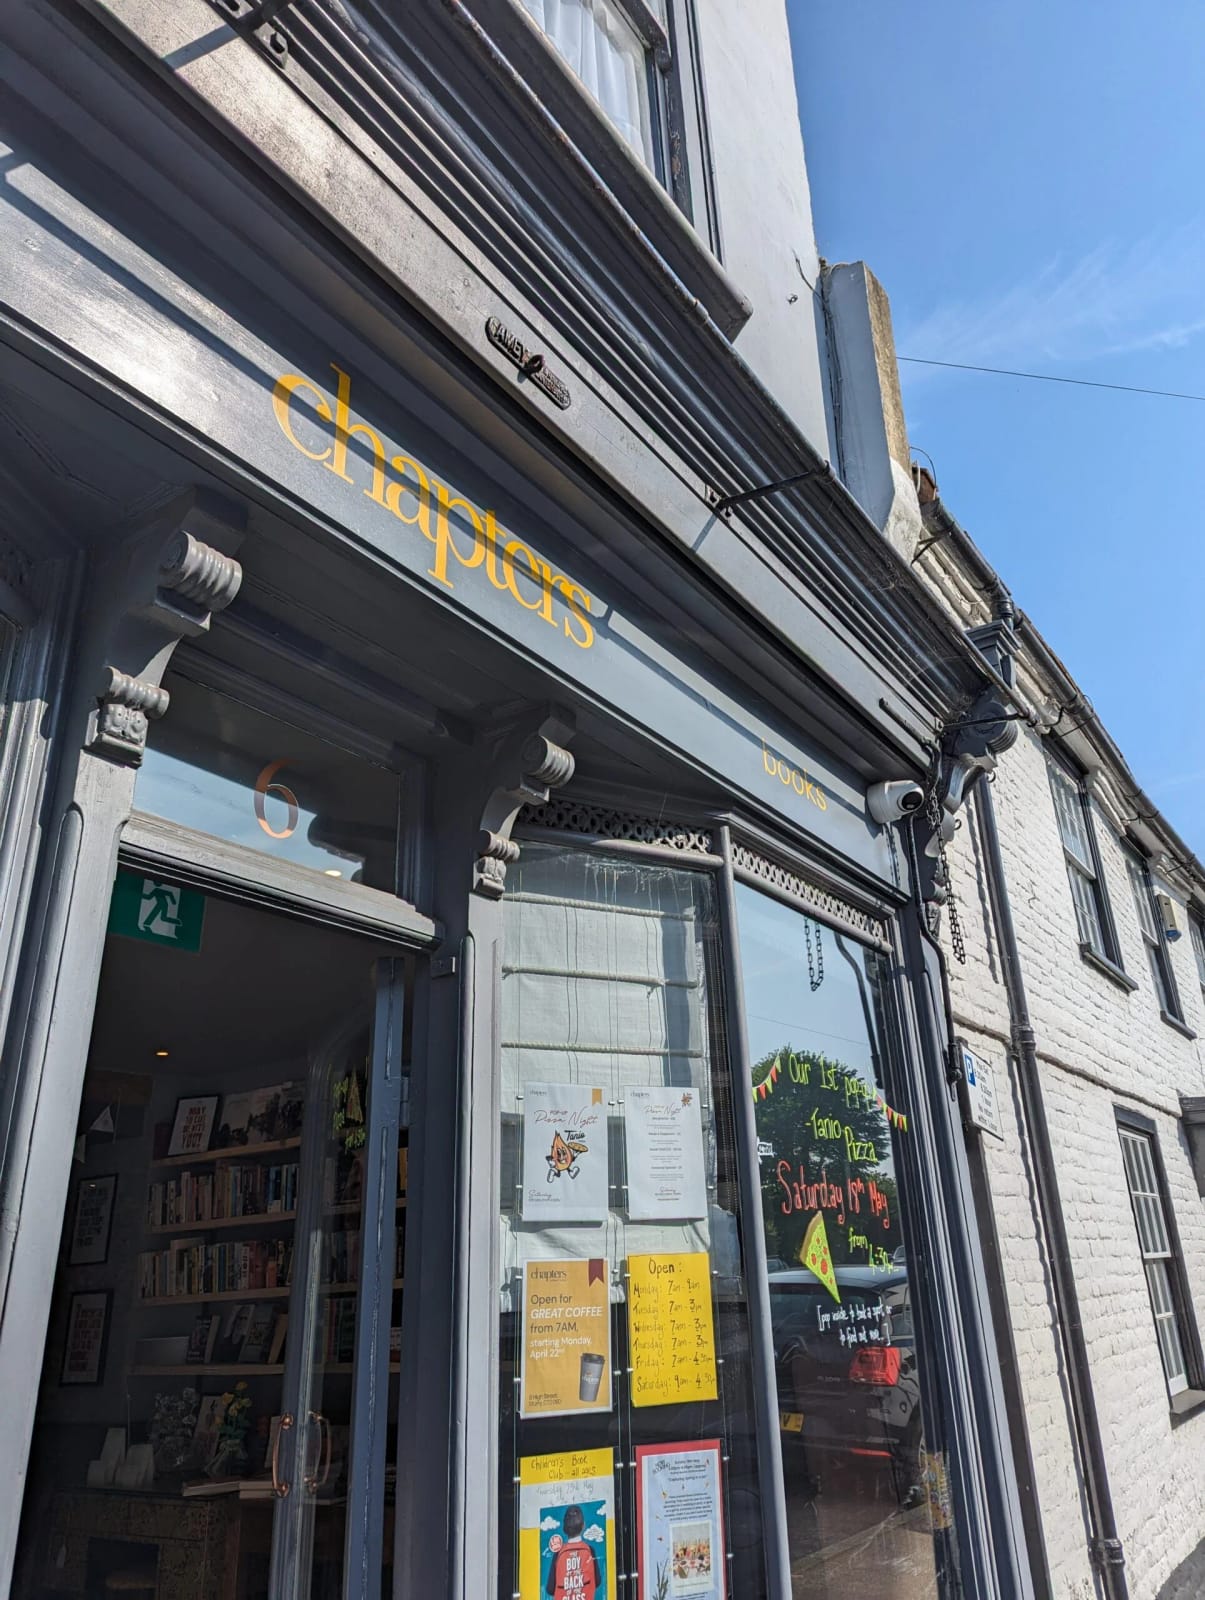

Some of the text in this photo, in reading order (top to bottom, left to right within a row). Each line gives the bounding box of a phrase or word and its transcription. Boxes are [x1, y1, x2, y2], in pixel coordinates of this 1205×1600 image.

[271, 361, 595, 649] chapters
[761, 737, 827, 811] books
[254, 757, 299, 839] 6
[789, 1054, 811, 1085] Our
[811, 1107, 842, 1139] Tanio
[844, 1126, 878, 1163] Pizza
[777, 1160, 845, 1225] Saturday
[868, 1181, 890, 1229] May
[848, 1227, 868, 1253] from
[530, 1267, 568, 1282] chapters
[531, 1294, 573, 1306] Open for
[531, 1306, 603, 1319] GREAT COFFEE
[530, 1323, 553, 1334] from
[530, 1339, 560, 1348] starting
[530, 1350, 548, 1360] April
[549, 1468, 564, 1480] Club
[566, 1556, 580, 1571] BOY
[563, 1575, 583, 1590] BACK
